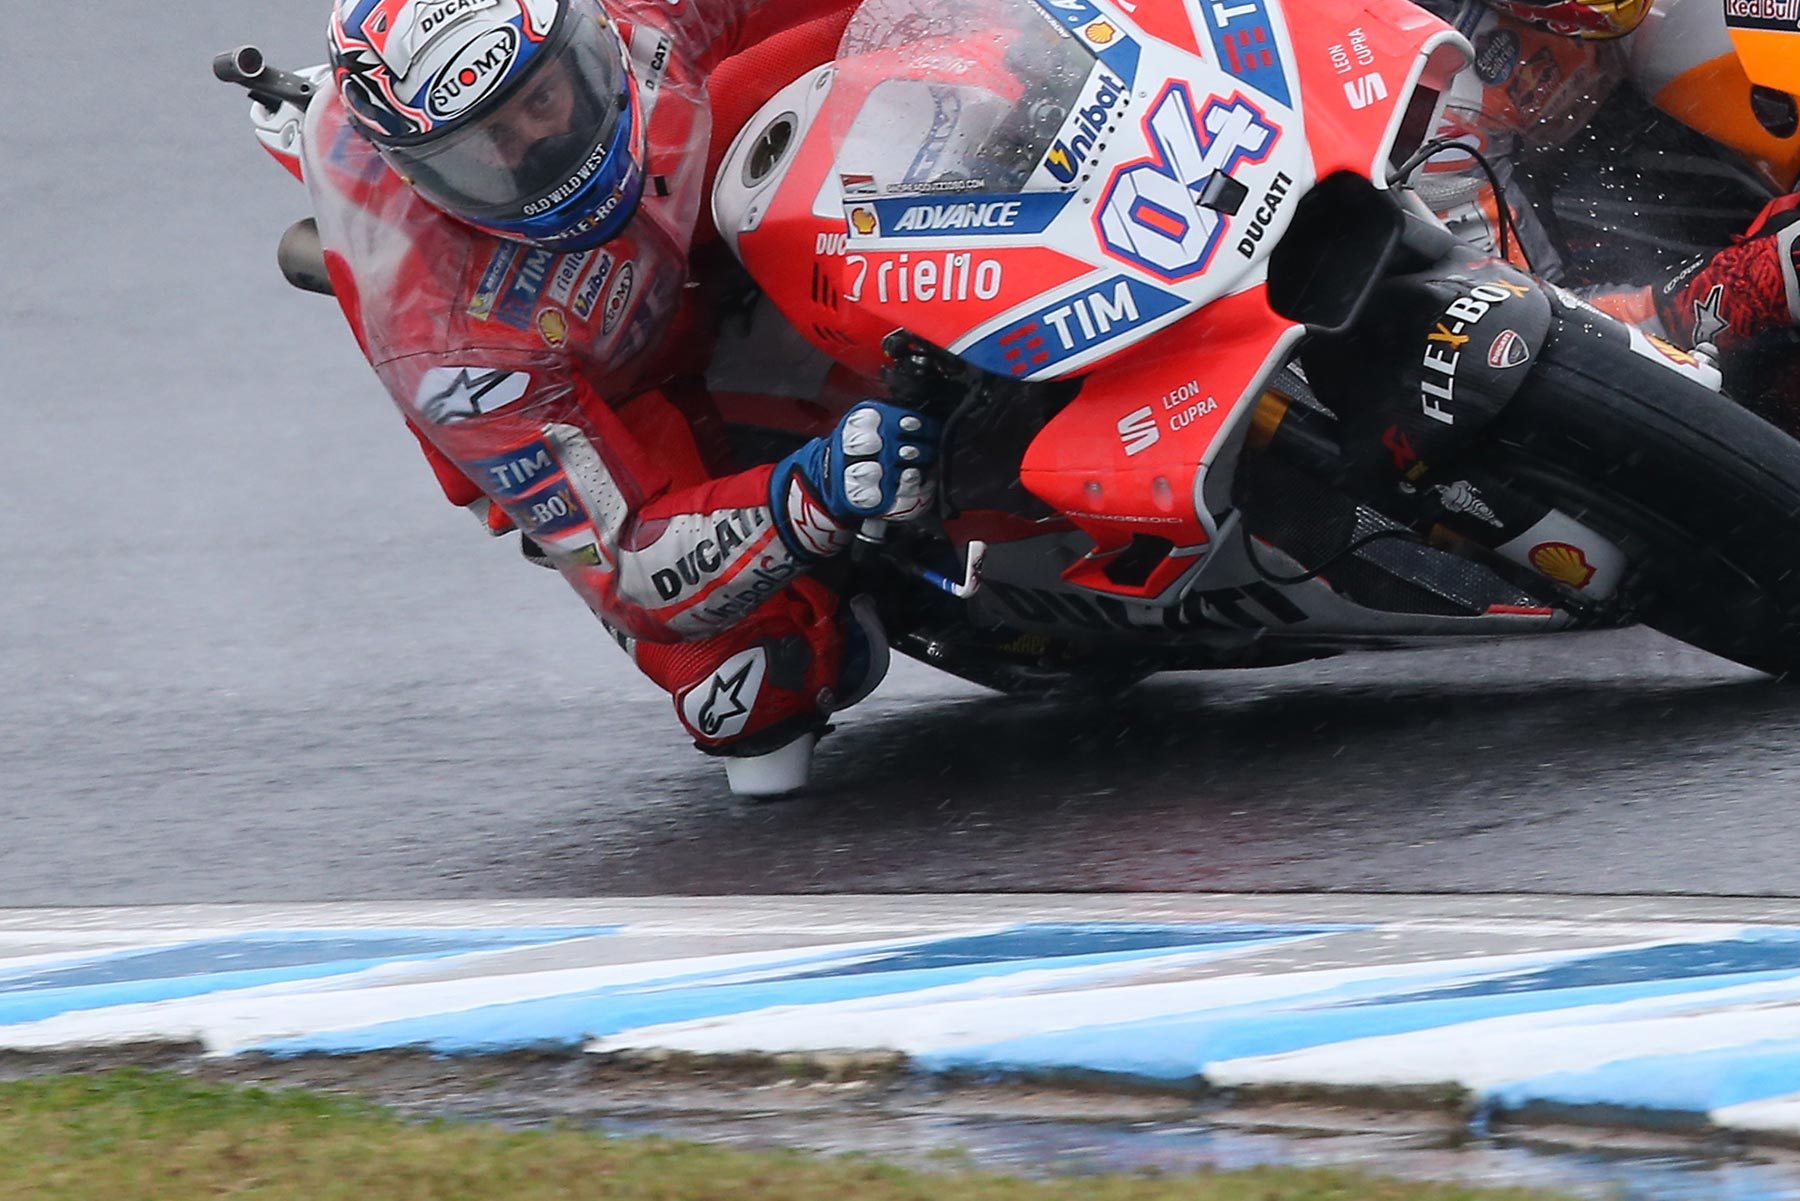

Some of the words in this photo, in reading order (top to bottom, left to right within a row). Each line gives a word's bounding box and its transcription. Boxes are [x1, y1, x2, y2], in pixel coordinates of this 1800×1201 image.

[432, 39, 515, 107] SUOMY
[1328, 45, 1352, 74] LEON
[1347, 27, 1375, 65] CUPRA
[1045, 75, 1126, 185] Unibat
[523, 198, 551, 215] OLD
[548, 176, 581, 203] WILD
[577, 143, 606, 180] WEST
[1091, 77, 1283, 285] 04
[893, 201, 1022, 232] ADVANCE
[1237, 171, 1293, 259] DUCATI
[574, 254, 612, 318] Unibat
[877, 253, 1002, 303] riello
[1044, 281, 1140, 350] TIM
[1421, 280, 1530, 425] FLEX-BOX
[1162, 380, 1200, 410] LEON
[1169, 396, 1218, 432] CUPRA
[490, 449, 551, 489] TIM
